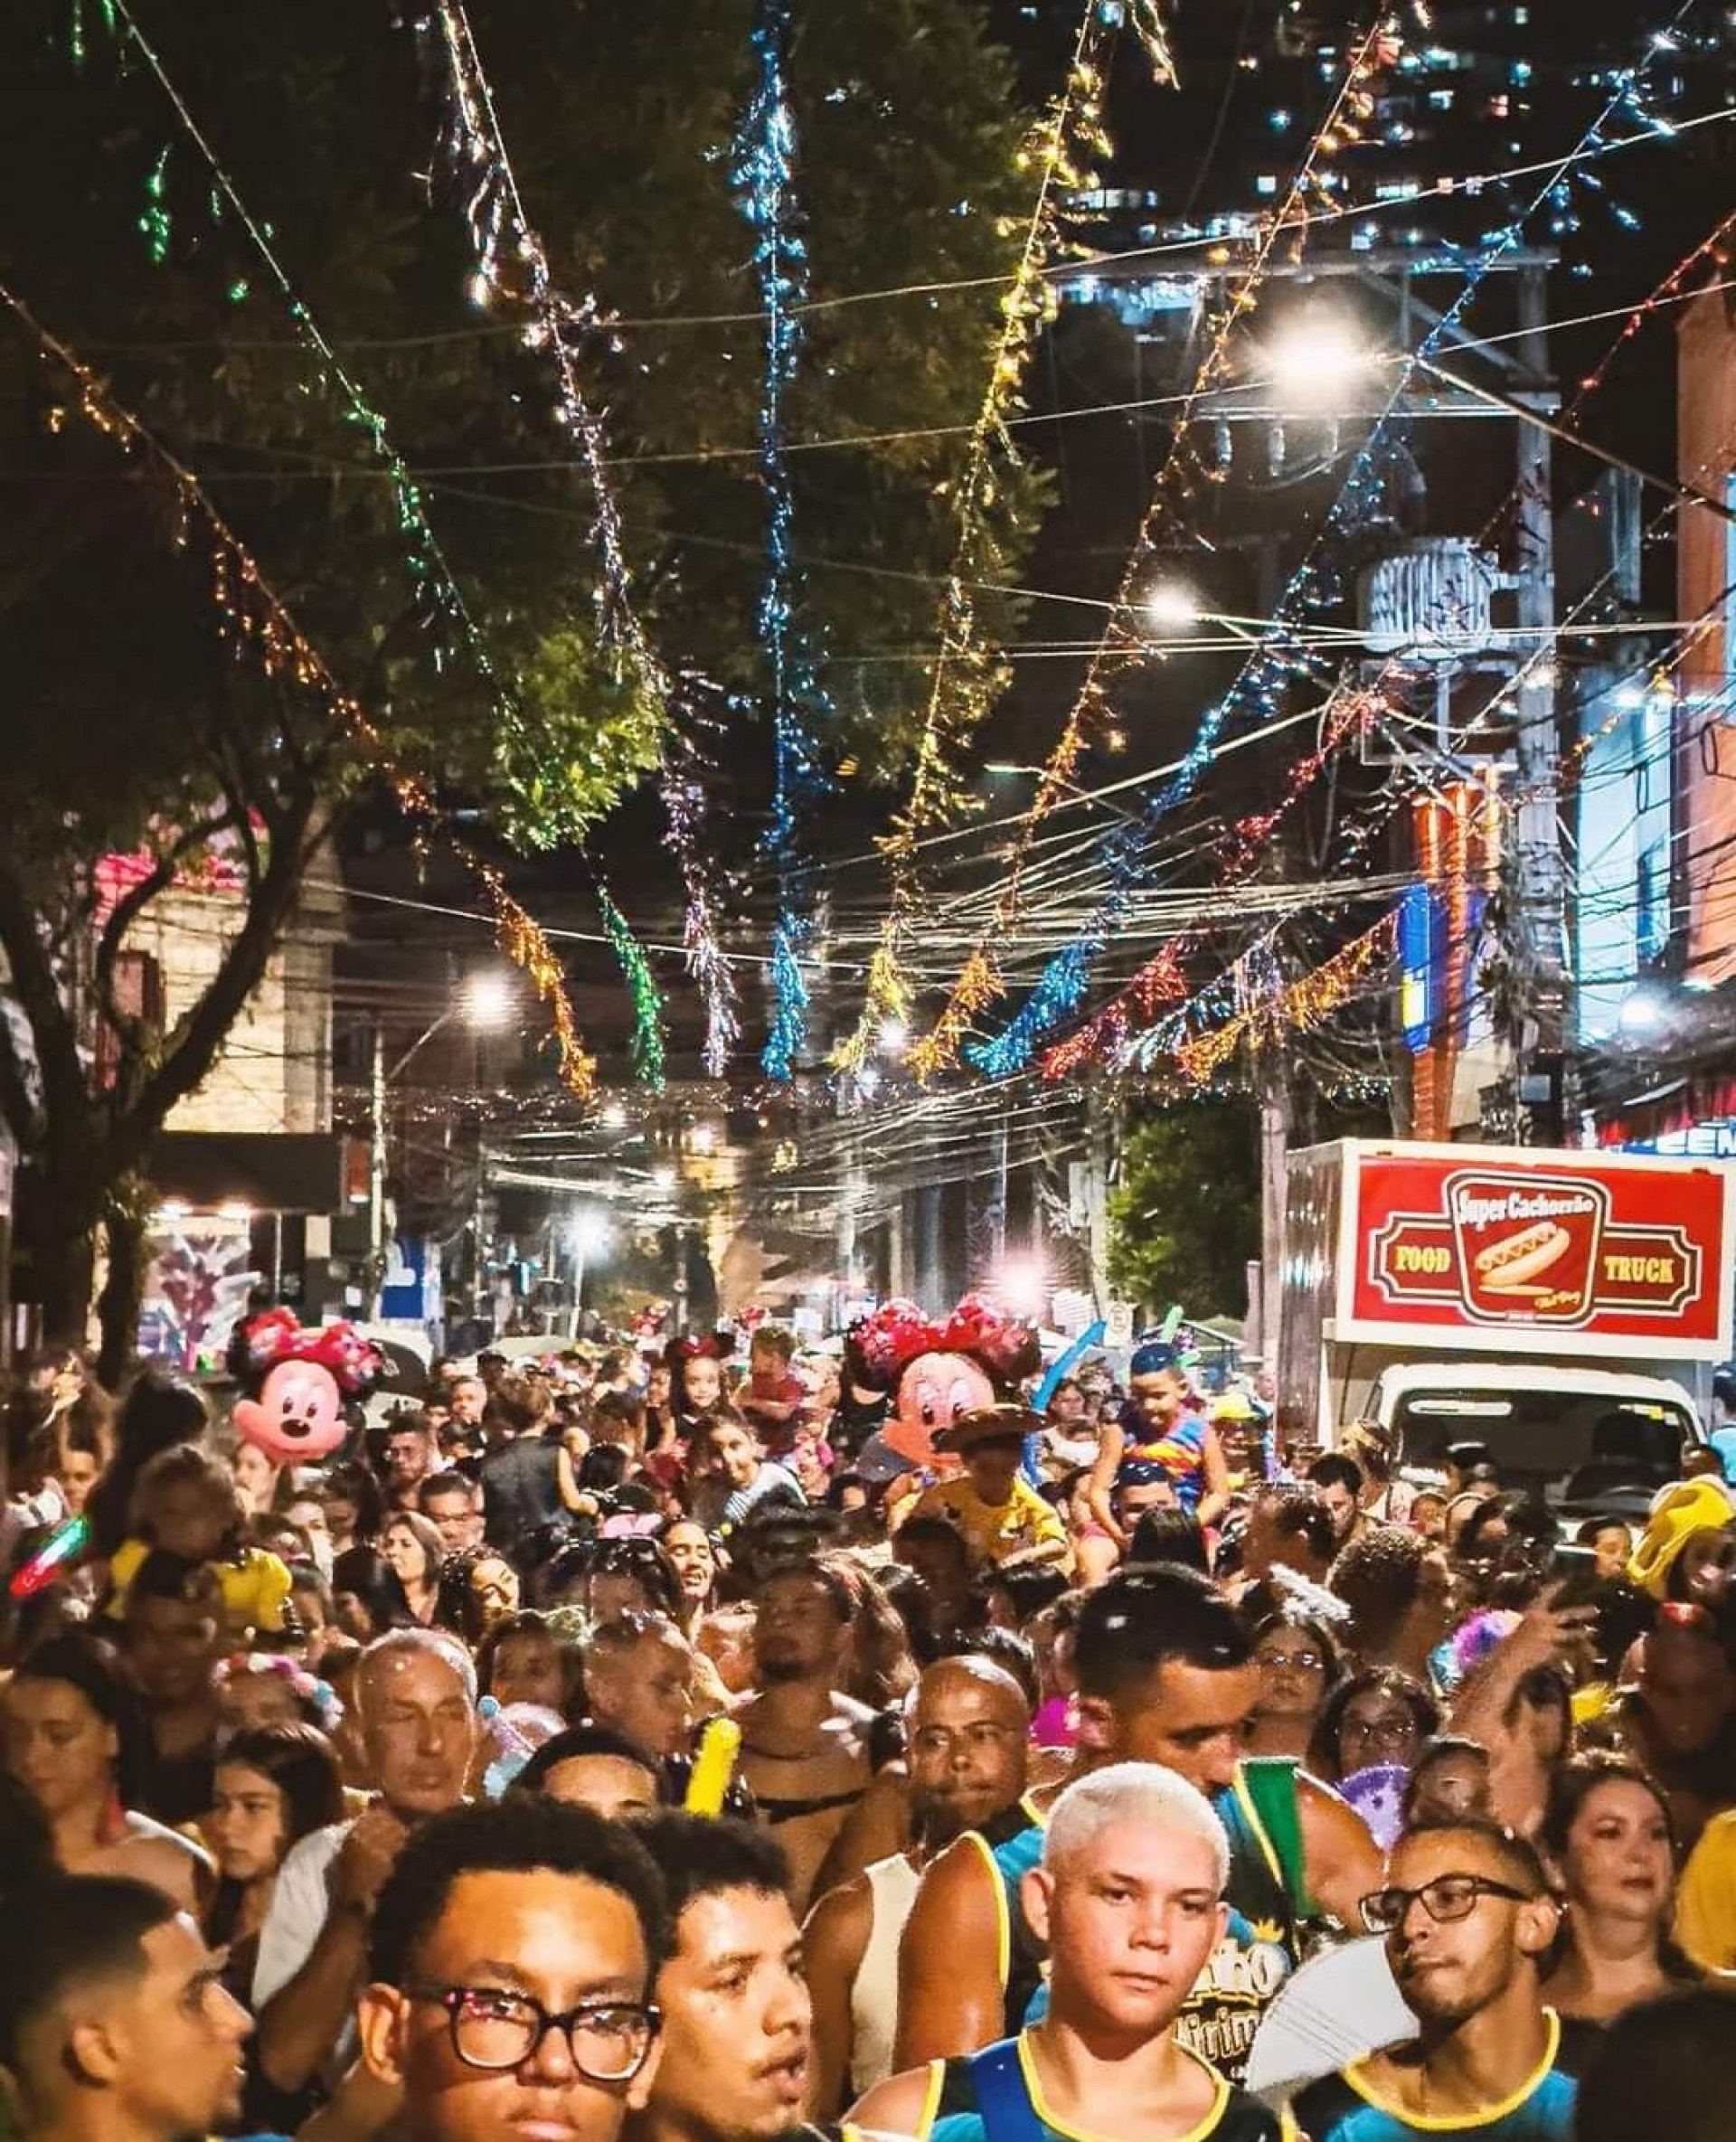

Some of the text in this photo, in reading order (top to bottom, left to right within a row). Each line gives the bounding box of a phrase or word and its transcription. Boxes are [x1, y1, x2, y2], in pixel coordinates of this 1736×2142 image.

[1457, 1189, 1507, 1231] Super
[1395, 1245, 1451, 1273] FOOD
[1604, 1255, 1675, 1284] TRUCK
